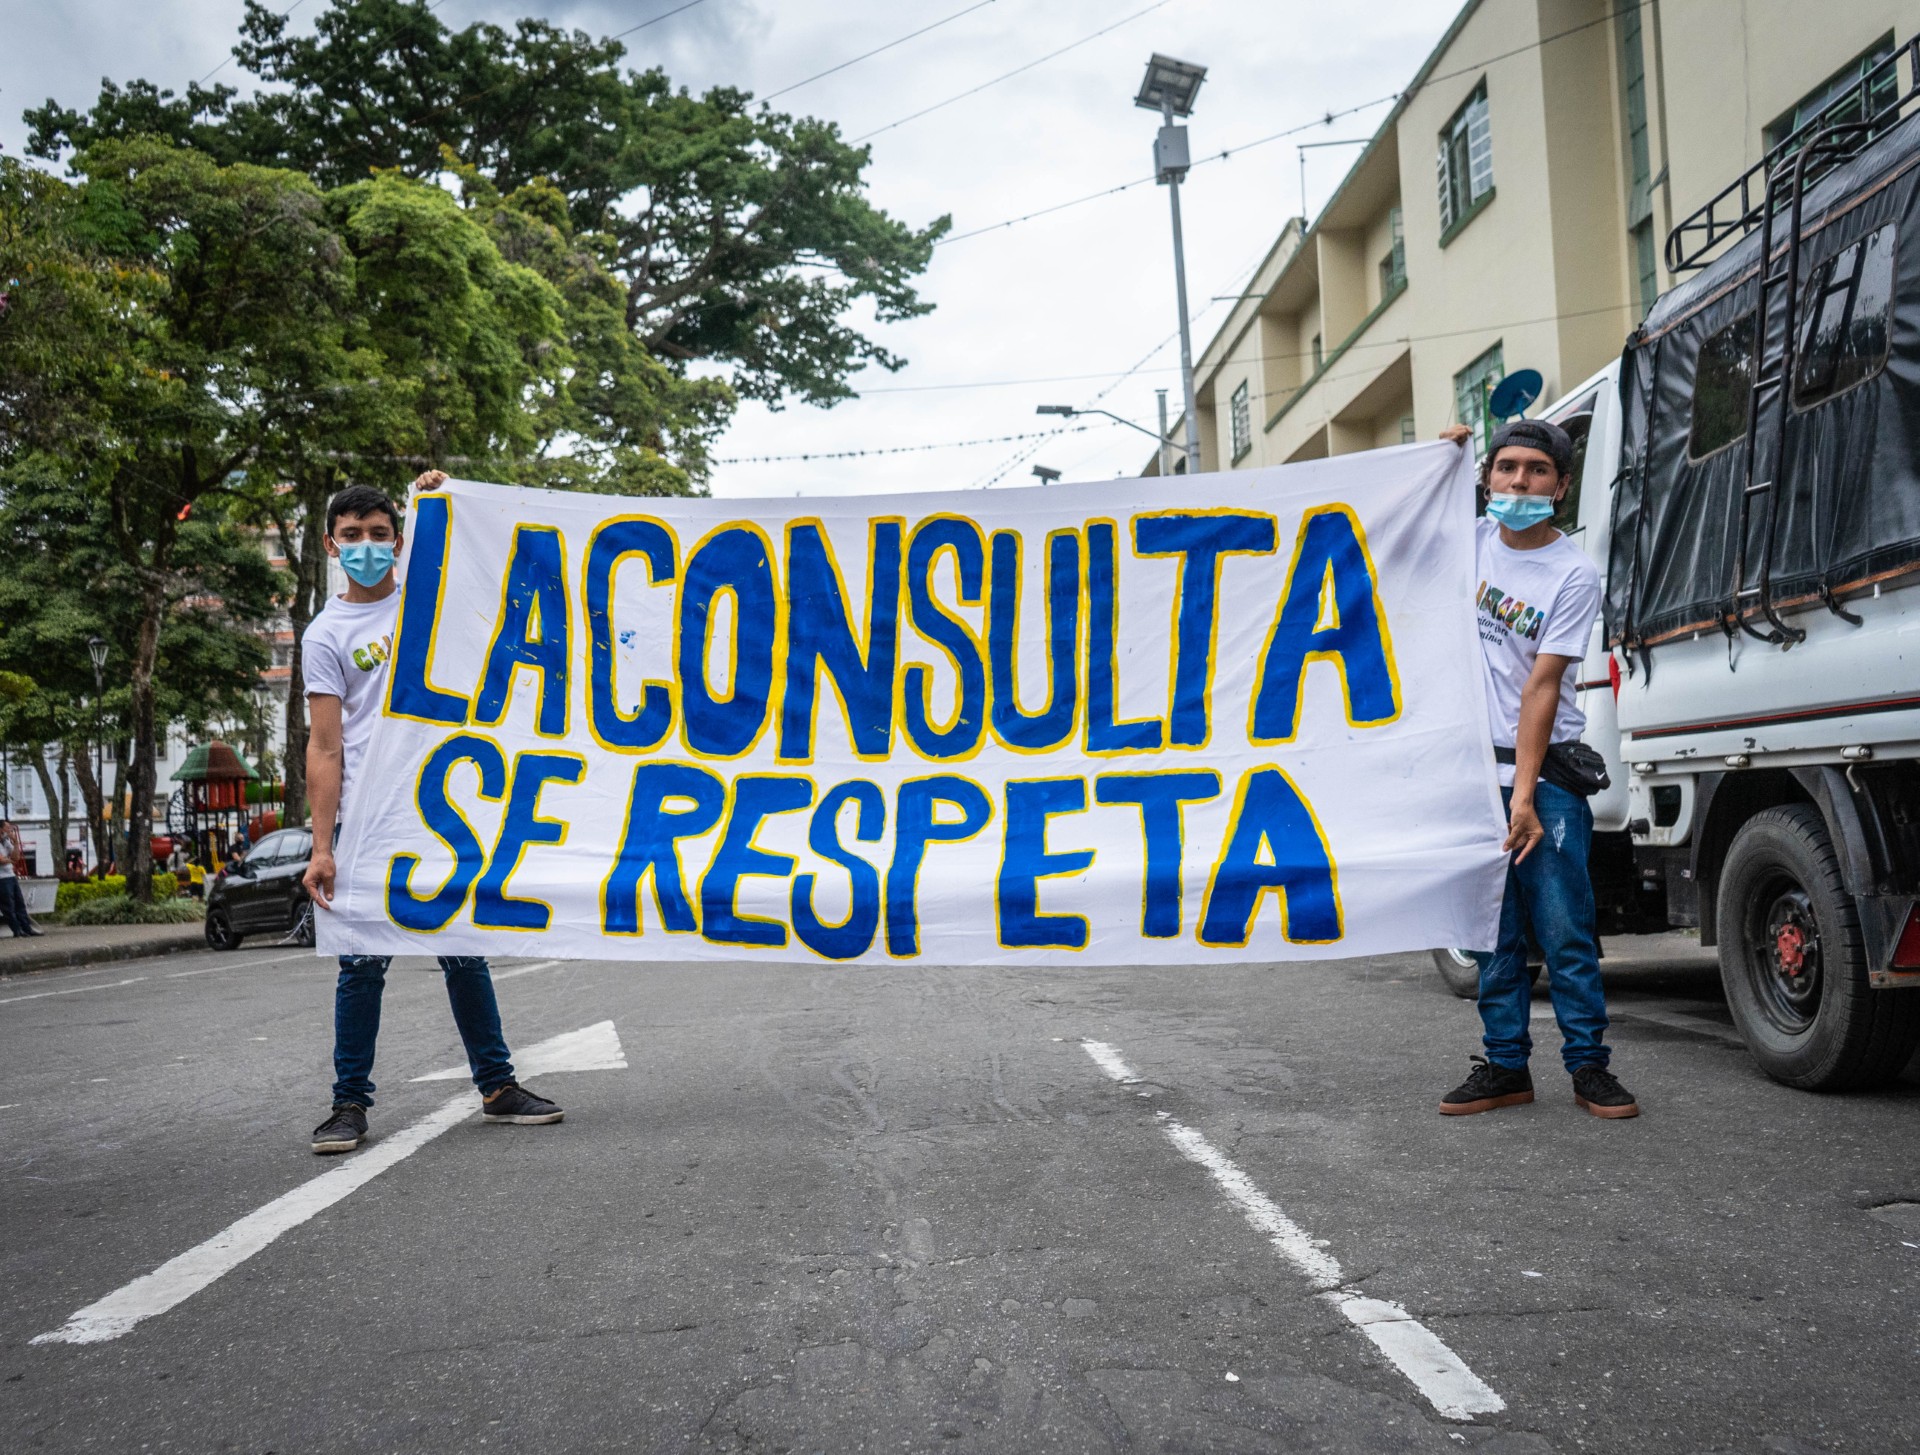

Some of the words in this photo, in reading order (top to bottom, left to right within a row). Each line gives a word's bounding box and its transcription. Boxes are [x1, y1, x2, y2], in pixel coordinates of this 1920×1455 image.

[382, 493, 573, 738] LA
[581, 502, 1403, 766] CONSULTA
[385, 731, 587, 934] SE
[599, 759, 1345, 961] RESPETA
